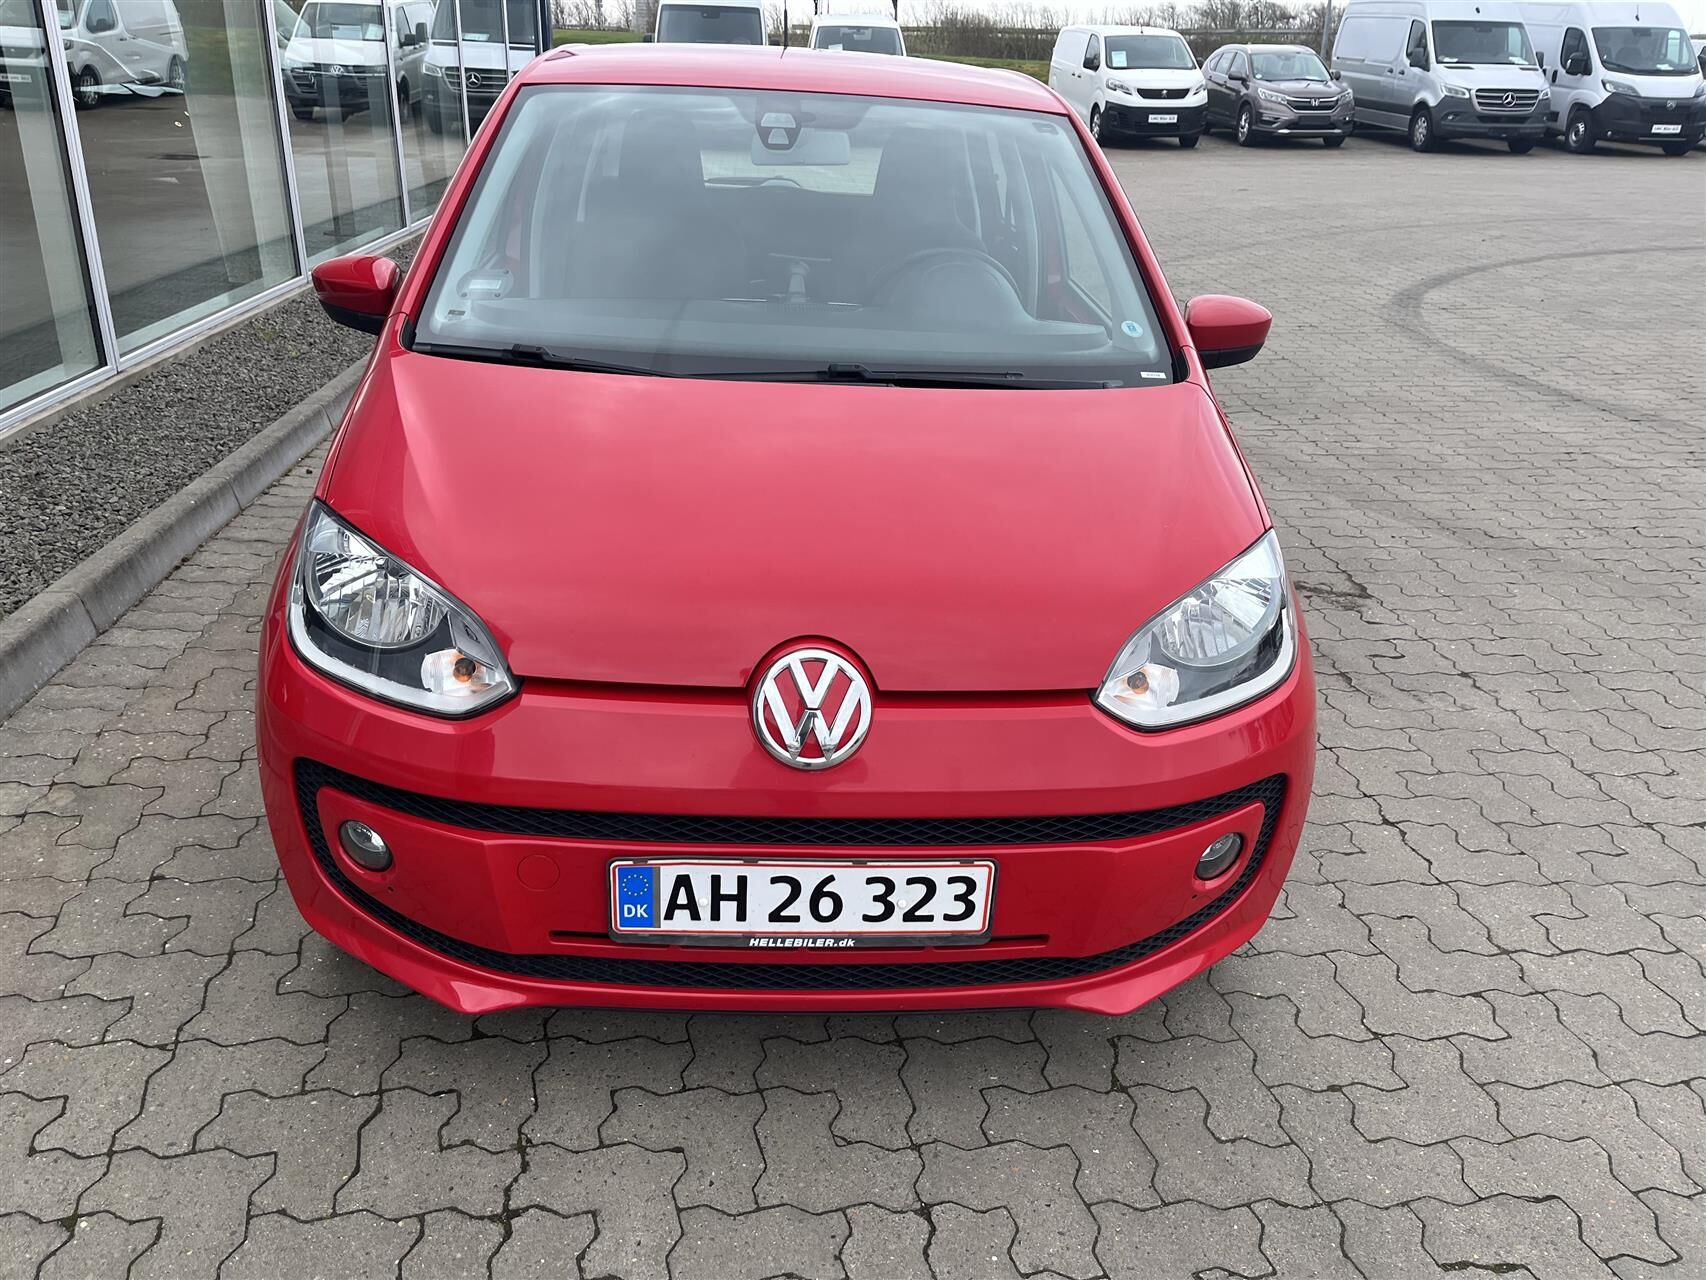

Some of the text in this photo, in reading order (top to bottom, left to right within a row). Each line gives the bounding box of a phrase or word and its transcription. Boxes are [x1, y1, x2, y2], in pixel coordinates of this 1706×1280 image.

[663, 874, 978, 923] AH 26 323
[623, 904, 649, 918] DK
[749, 938, 855, 947] HELLEBILER.dk
